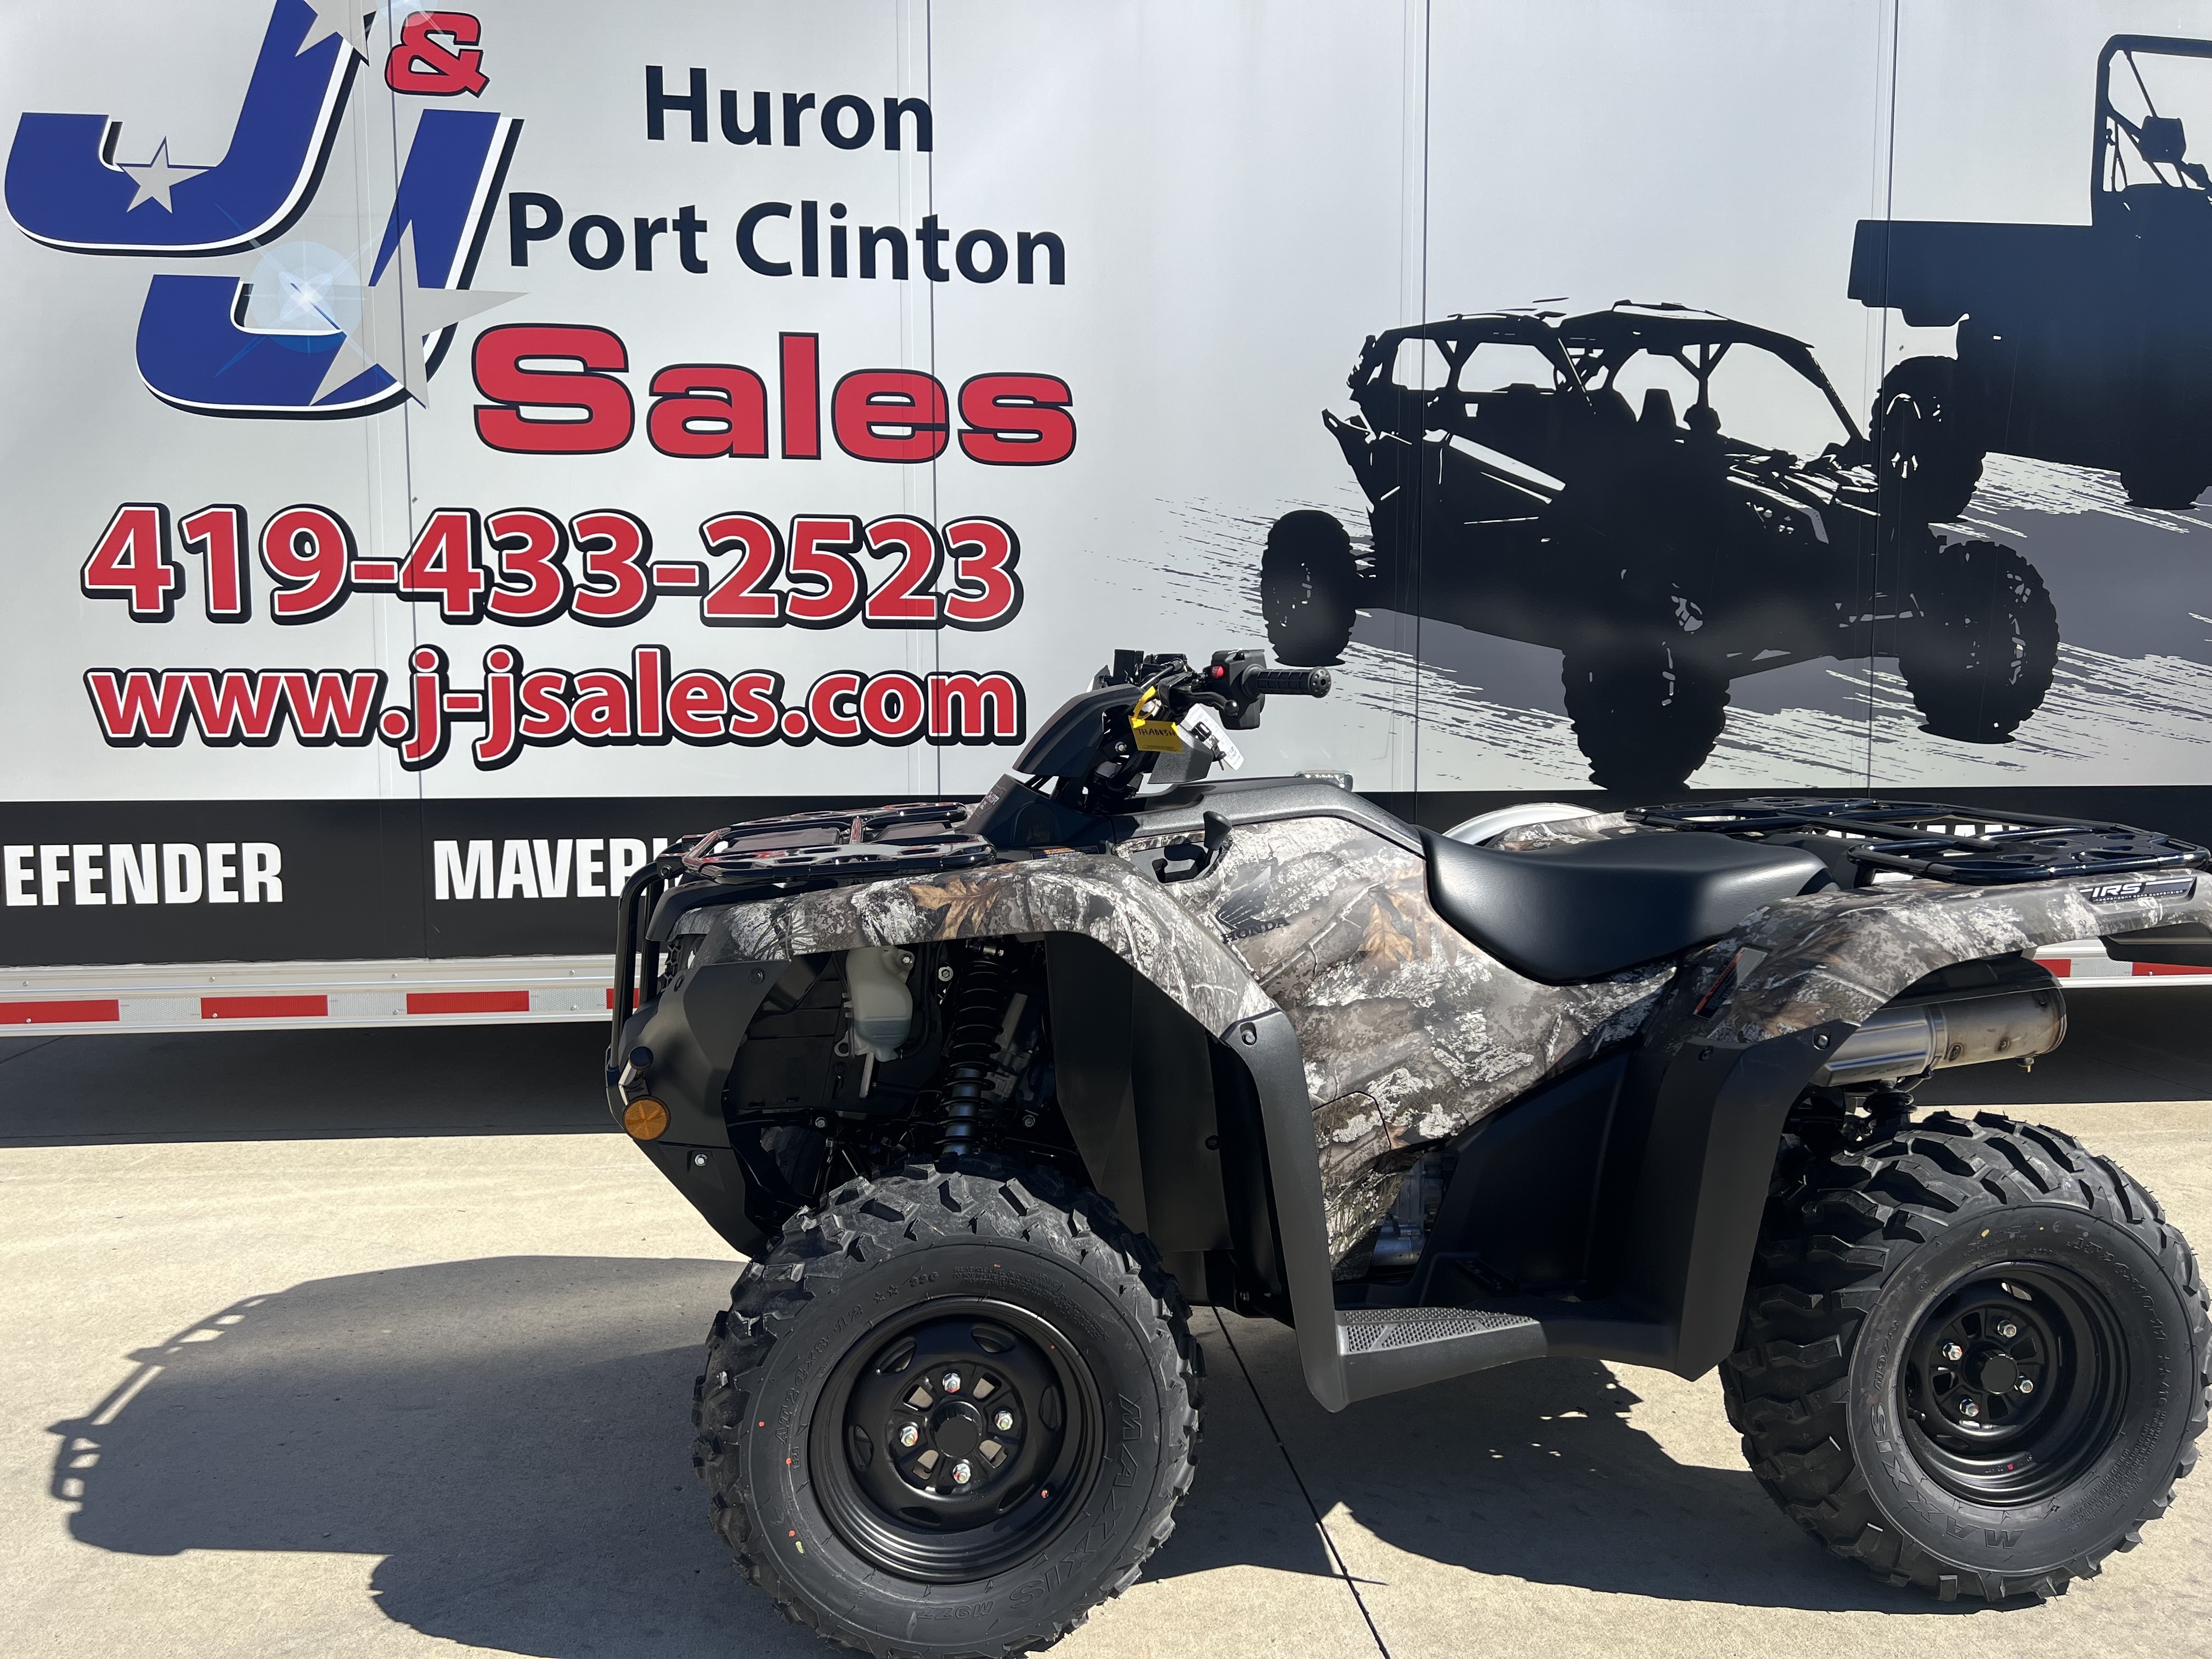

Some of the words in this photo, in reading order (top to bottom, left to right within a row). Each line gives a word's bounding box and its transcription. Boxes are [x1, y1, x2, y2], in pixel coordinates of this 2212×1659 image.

[645, 64, 933, 153] Huron
[508, 191, 708, 274] Port
[735, 199, 1066, 286] Clinton
[471, 322, 1077, 467] Sales
[81, 503, 1024, 632] 419-433-2523
[83, 644, 1026, 772] www.j-jsales.com
[1221, 917, 1290, 944] HONDA
[2092, 883, 2142, 898] IRS
[1009, 1393, 1142, 1609] MAXXIS
[1870, 1402, 2027, 1550] MAXXIS
